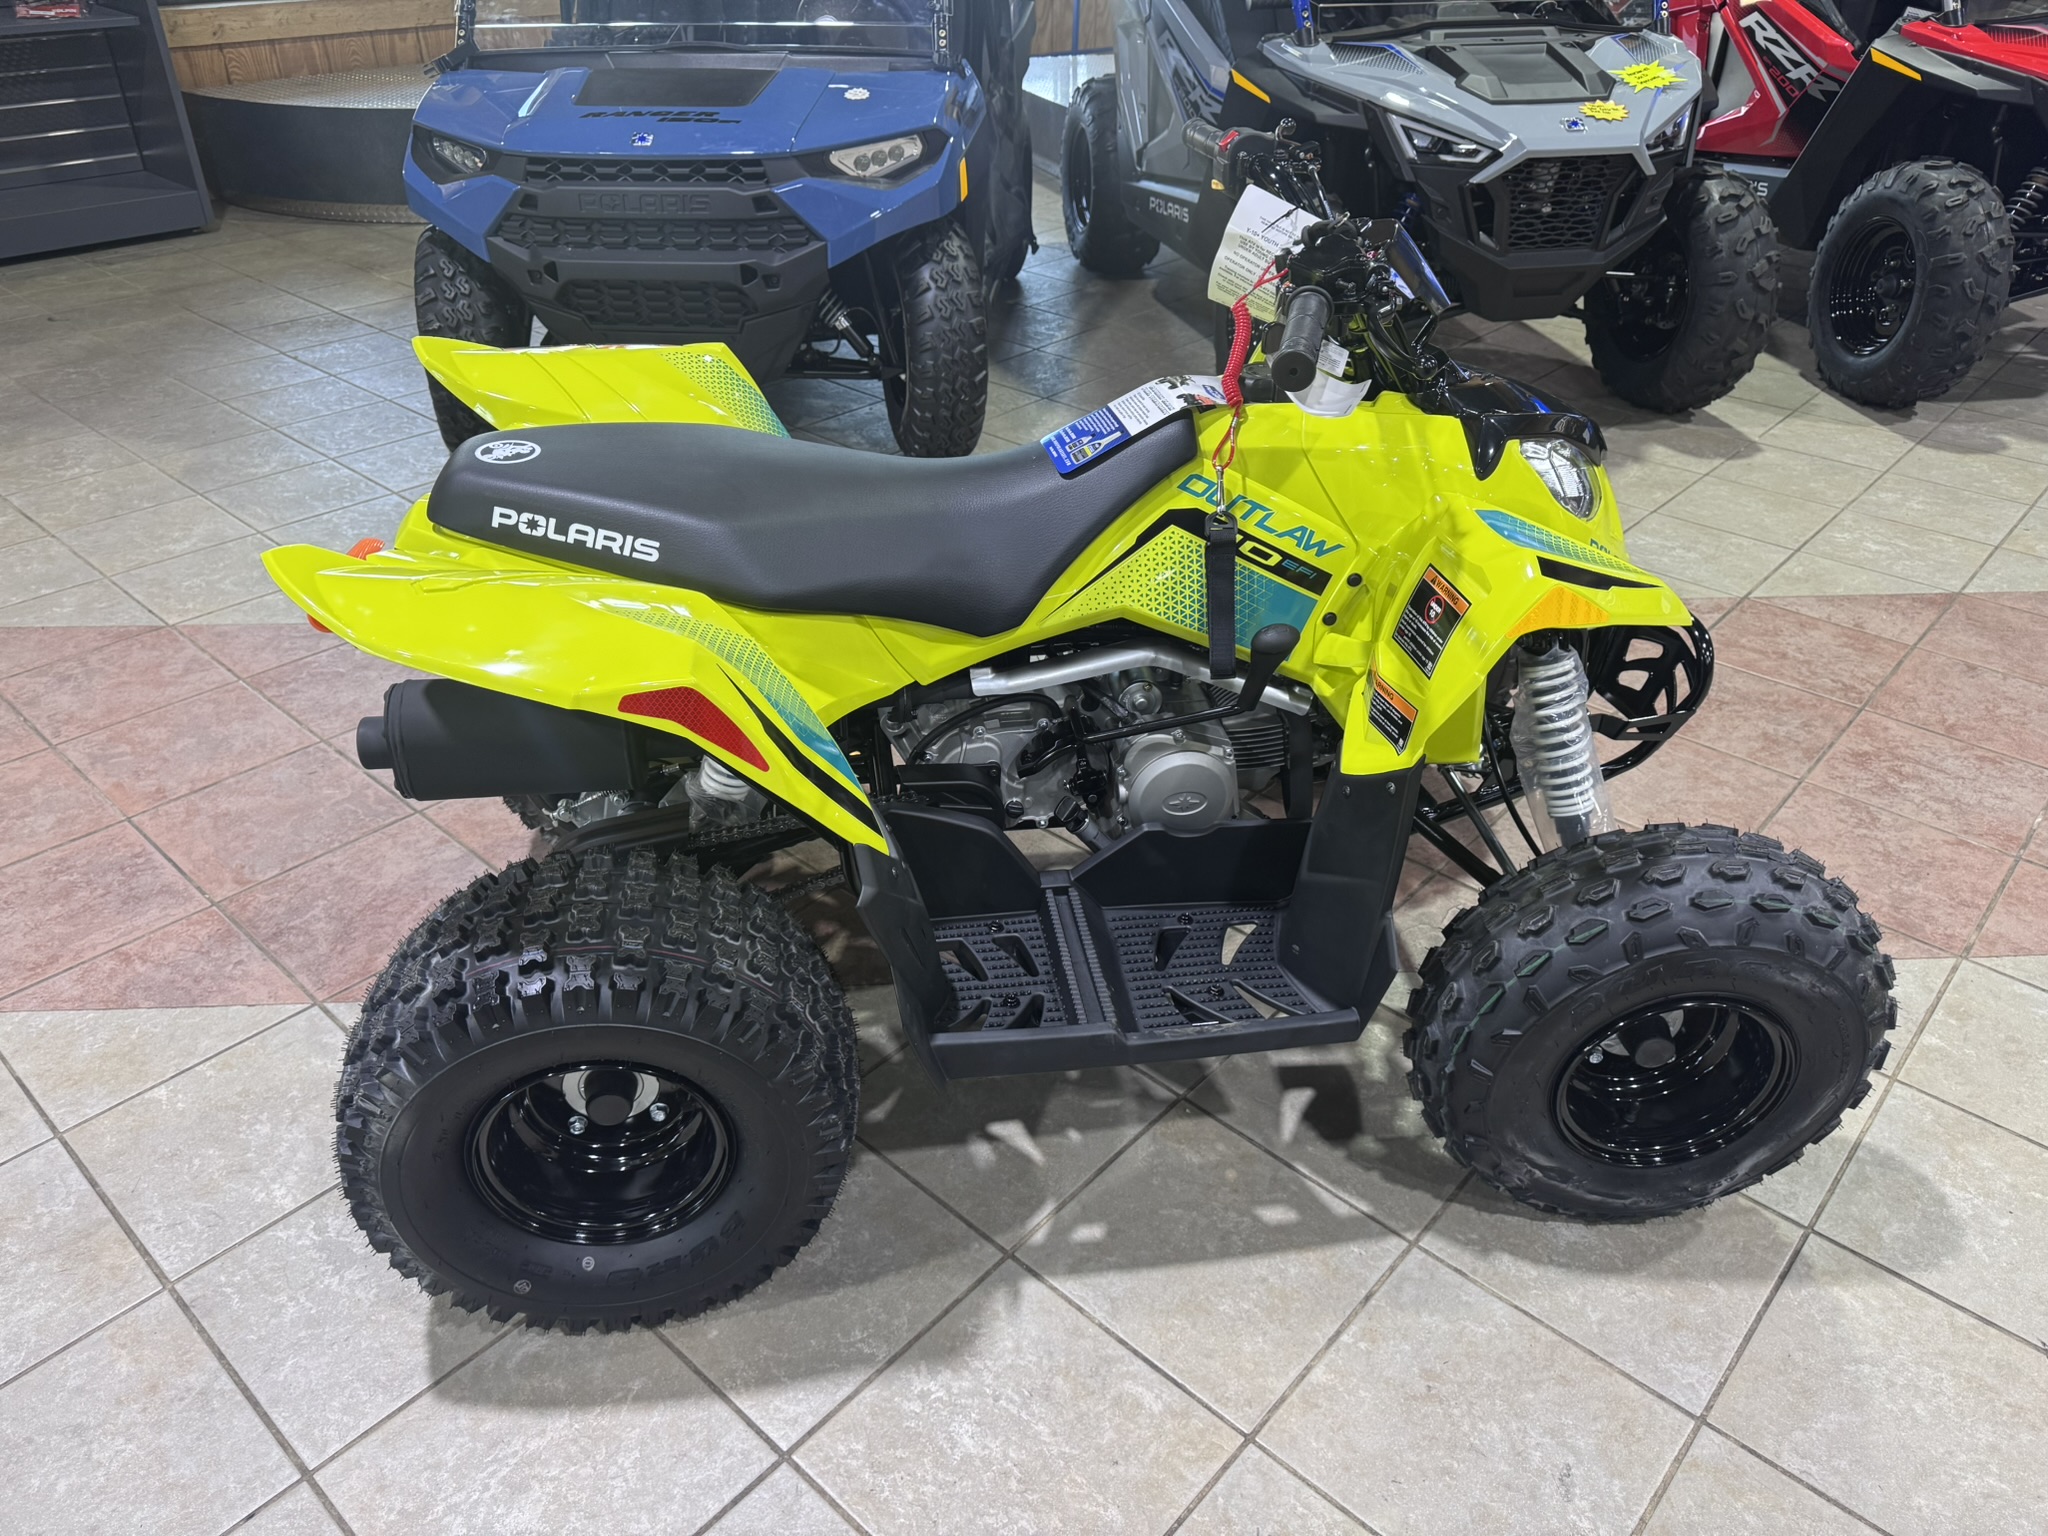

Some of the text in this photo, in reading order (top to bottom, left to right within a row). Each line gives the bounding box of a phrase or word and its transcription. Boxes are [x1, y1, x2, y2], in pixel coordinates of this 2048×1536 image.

[1739, 11, 1841, 103] RZR
[1769, 65, 1800, 98] 200
[579, 110, 721, 118] RANGER
[579, 192, 713, 215] POLARIS
[1149, 196, 1190, 223] POLARIS
[1259, 234, 1279, 248] YOUTH
[1177, 473, 1346, 559] OUTLAW
[491, 506, 661, 562] POLARIS
[1281, 558, 1318, 580] EFI
[1434, 578, 1459, 605] WARNING
